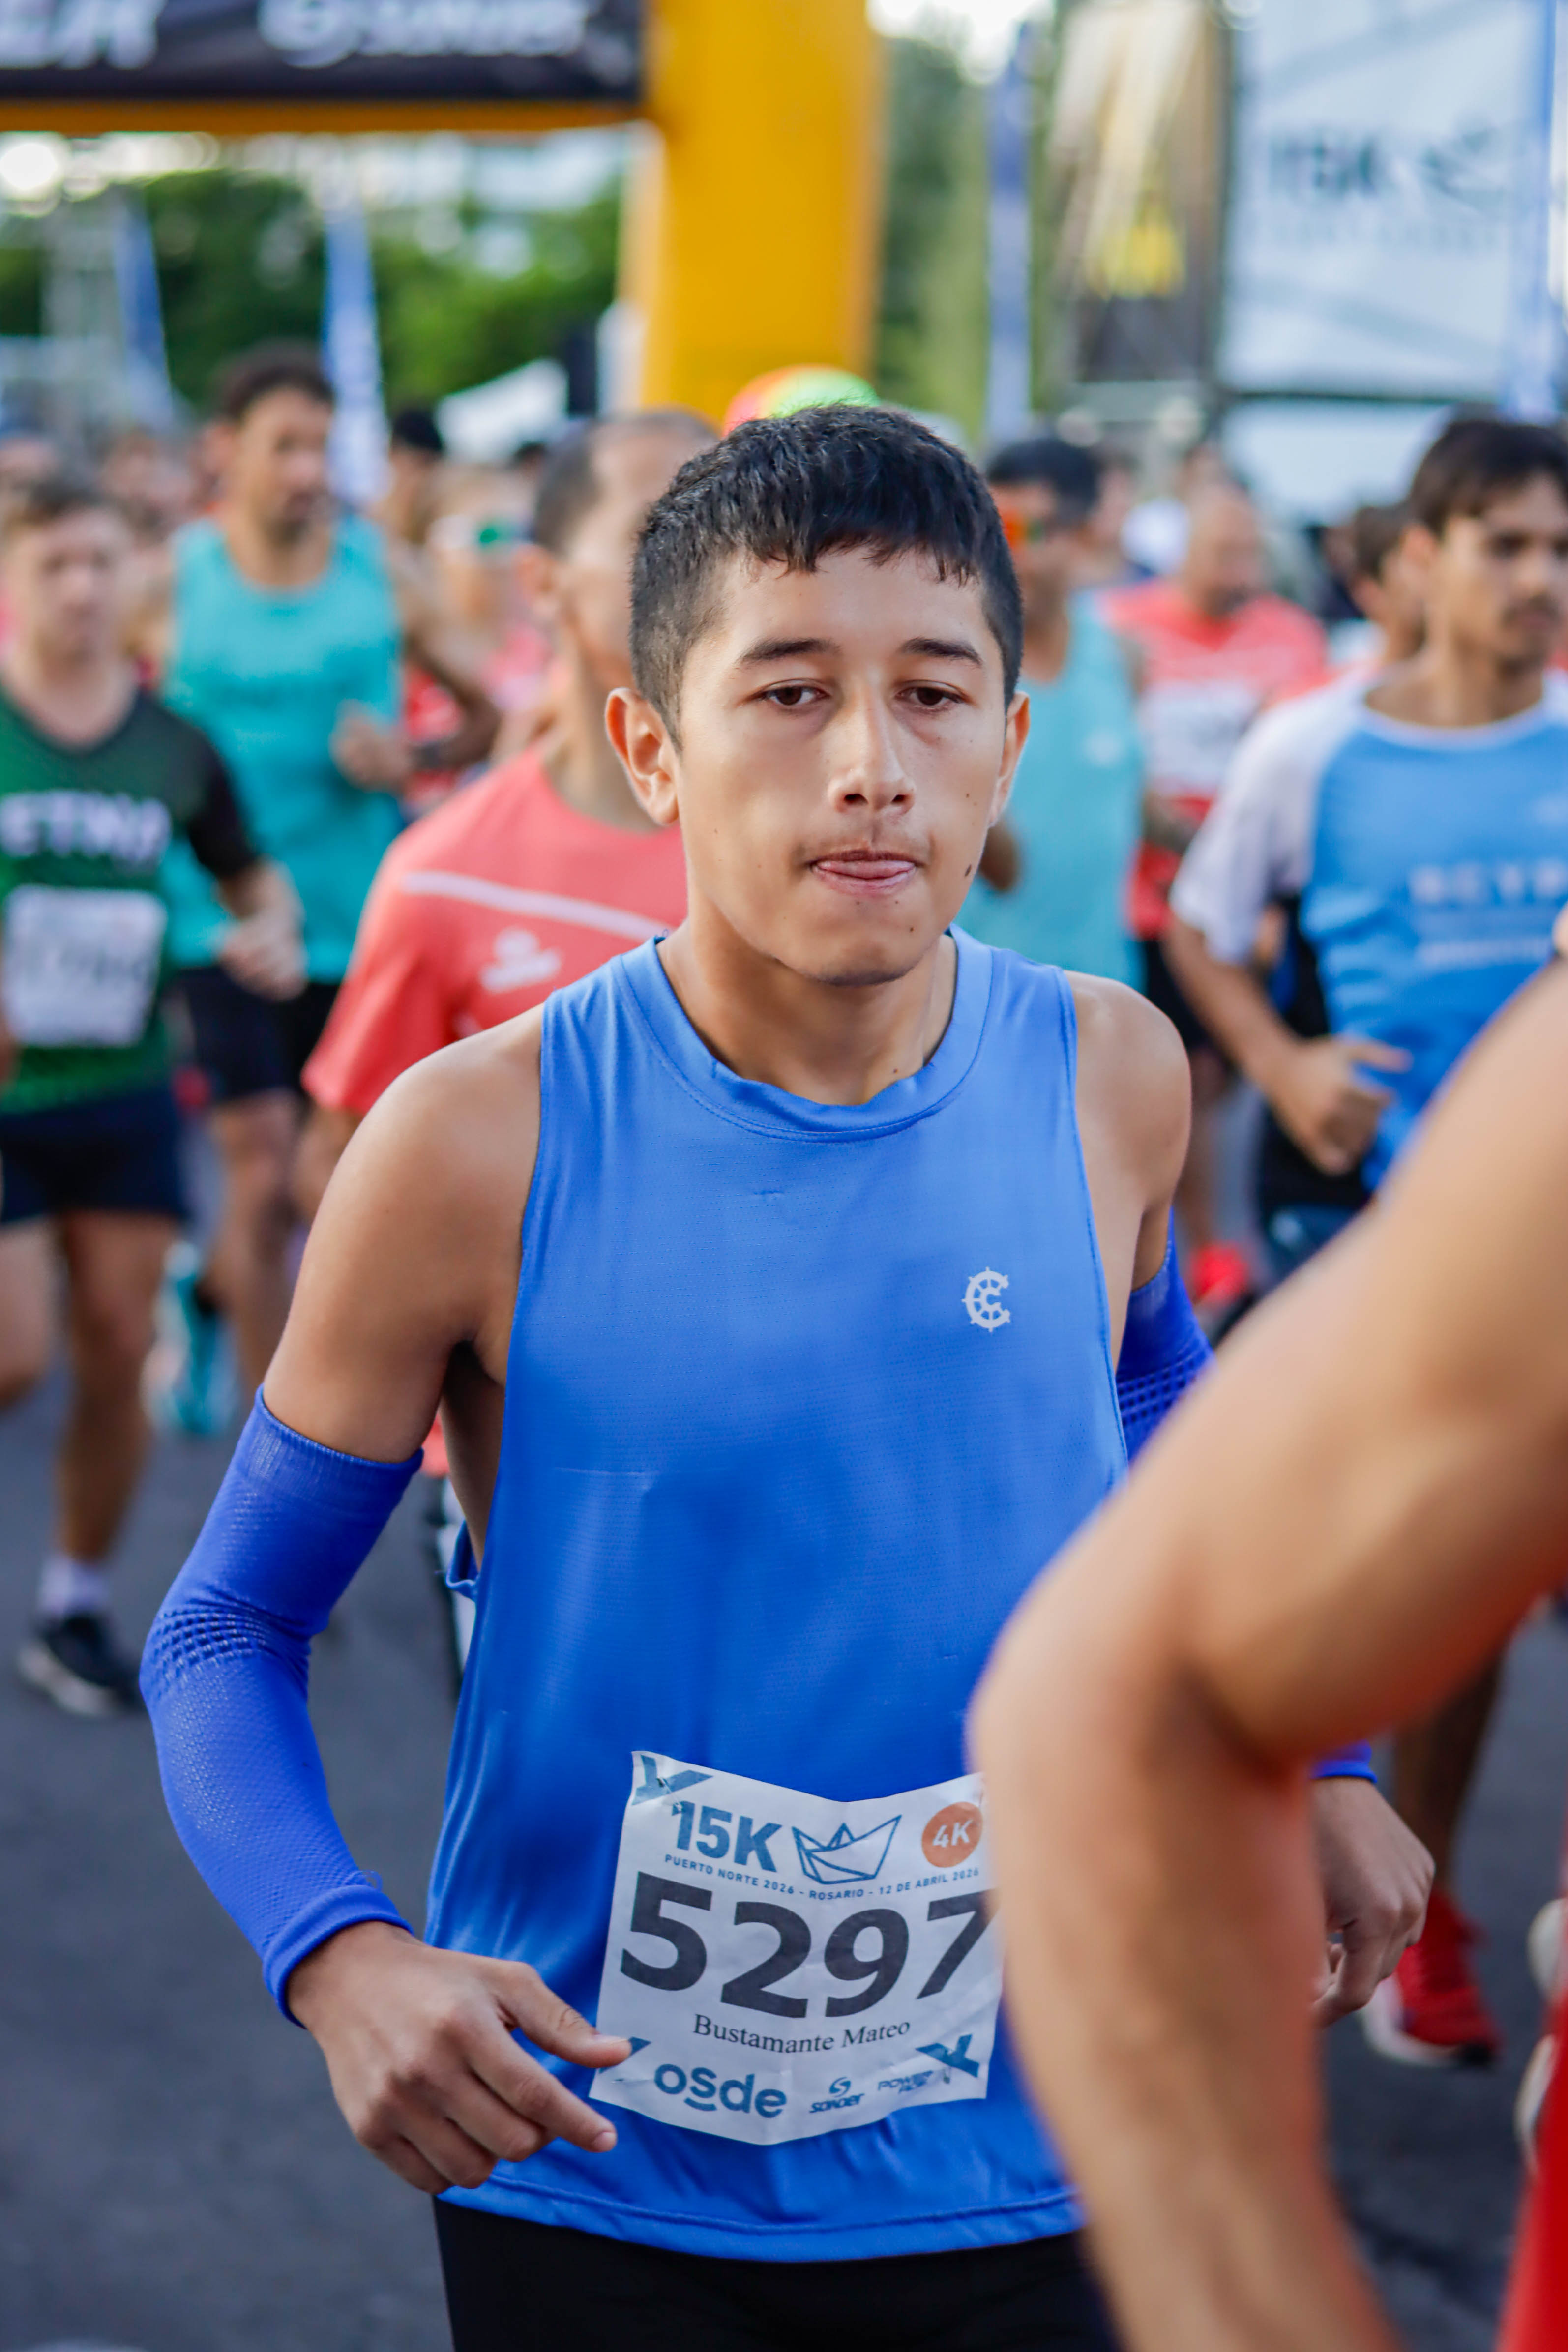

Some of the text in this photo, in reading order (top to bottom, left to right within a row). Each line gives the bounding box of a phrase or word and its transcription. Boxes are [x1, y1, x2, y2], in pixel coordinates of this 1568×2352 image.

[672, 1800, 782, 1872] 15K
[932, 1819, 974, 1848] 4K
[665, 1854, 713, 1874] PUERTO
[718, 1868, 759, 1886] NORTE
[764, 1880, 794, 1894] 2026
[809, 1888, 864, 1900] ROSARIO
[880, 1885, 892, 1894] 12
[896, 1882, 911, 1892] DE
[915, 1875, 948, 1888] ABRIL
[953, 1867, 979, 1881] 2026
[621, 1871, 1000, 2018] 5297
[693, 2014, 910, 2053] Bustamante Mateo
[654, 2064, 787, 2118] osde
